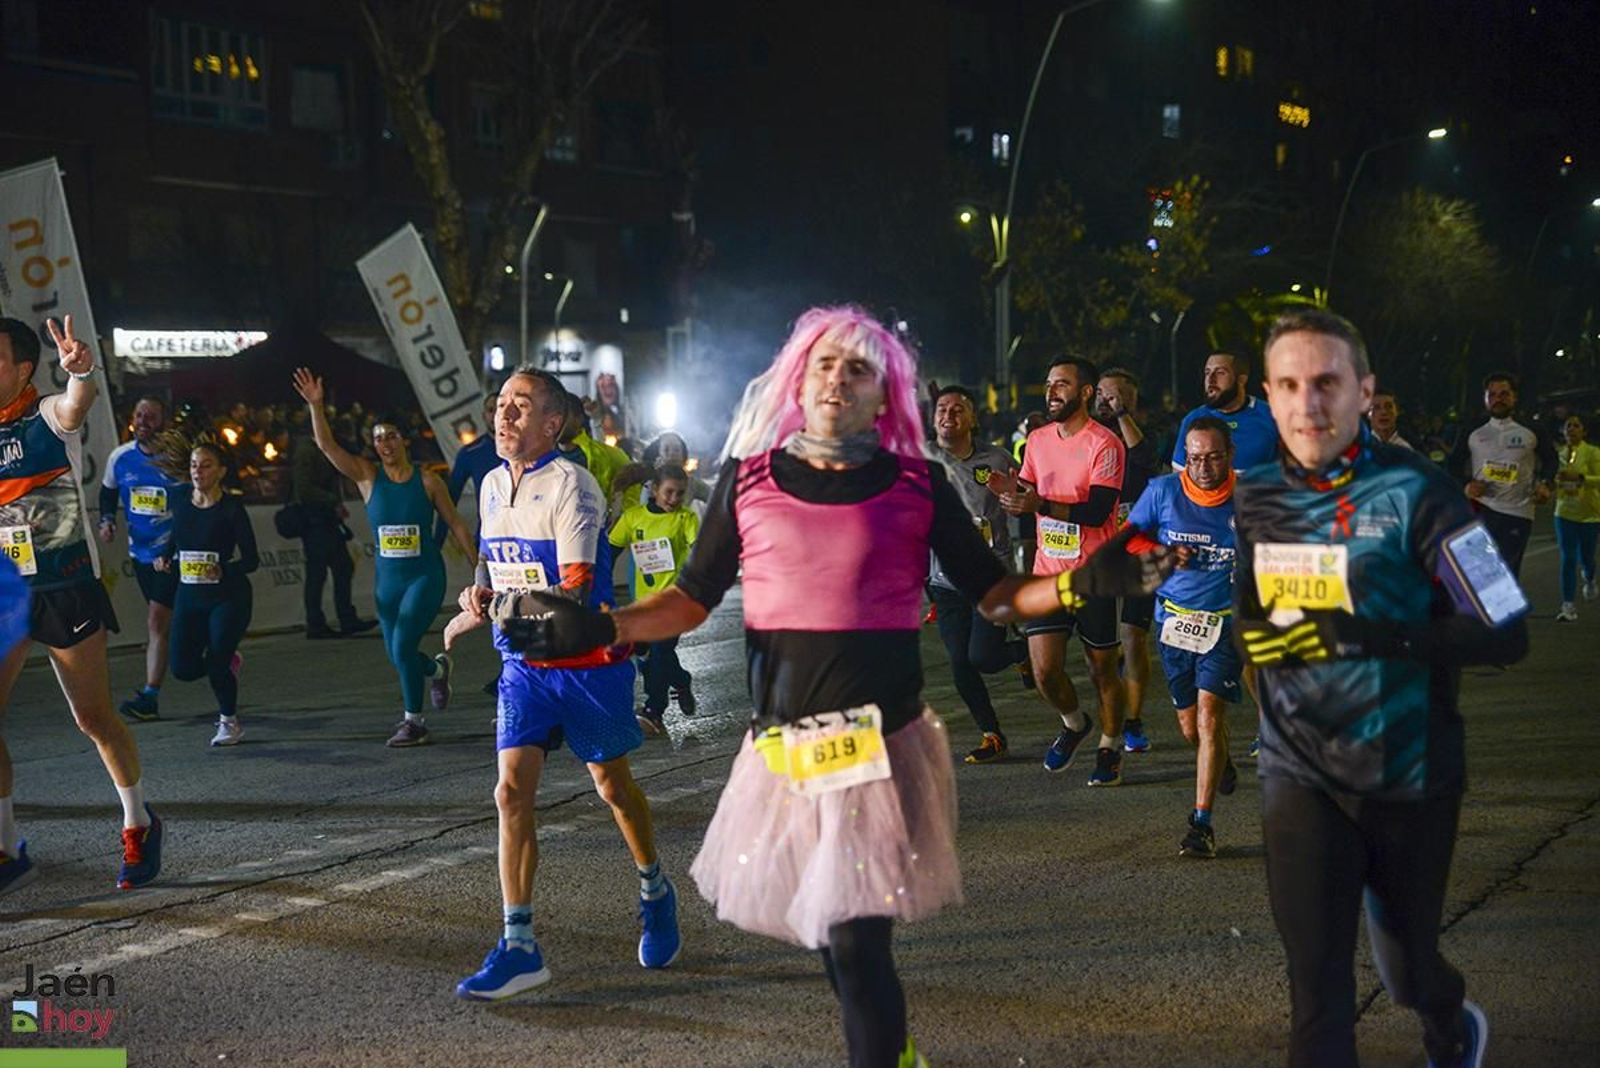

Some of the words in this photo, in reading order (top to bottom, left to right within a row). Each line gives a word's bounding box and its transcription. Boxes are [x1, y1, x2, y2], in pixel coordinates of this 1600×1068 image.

[1045, 532, 1070, 546] 2461
[1273, 577, 1327, 600] 3410
[1174, 620, 1209, 639] 2601
[813, 736, 857, 764] 619
